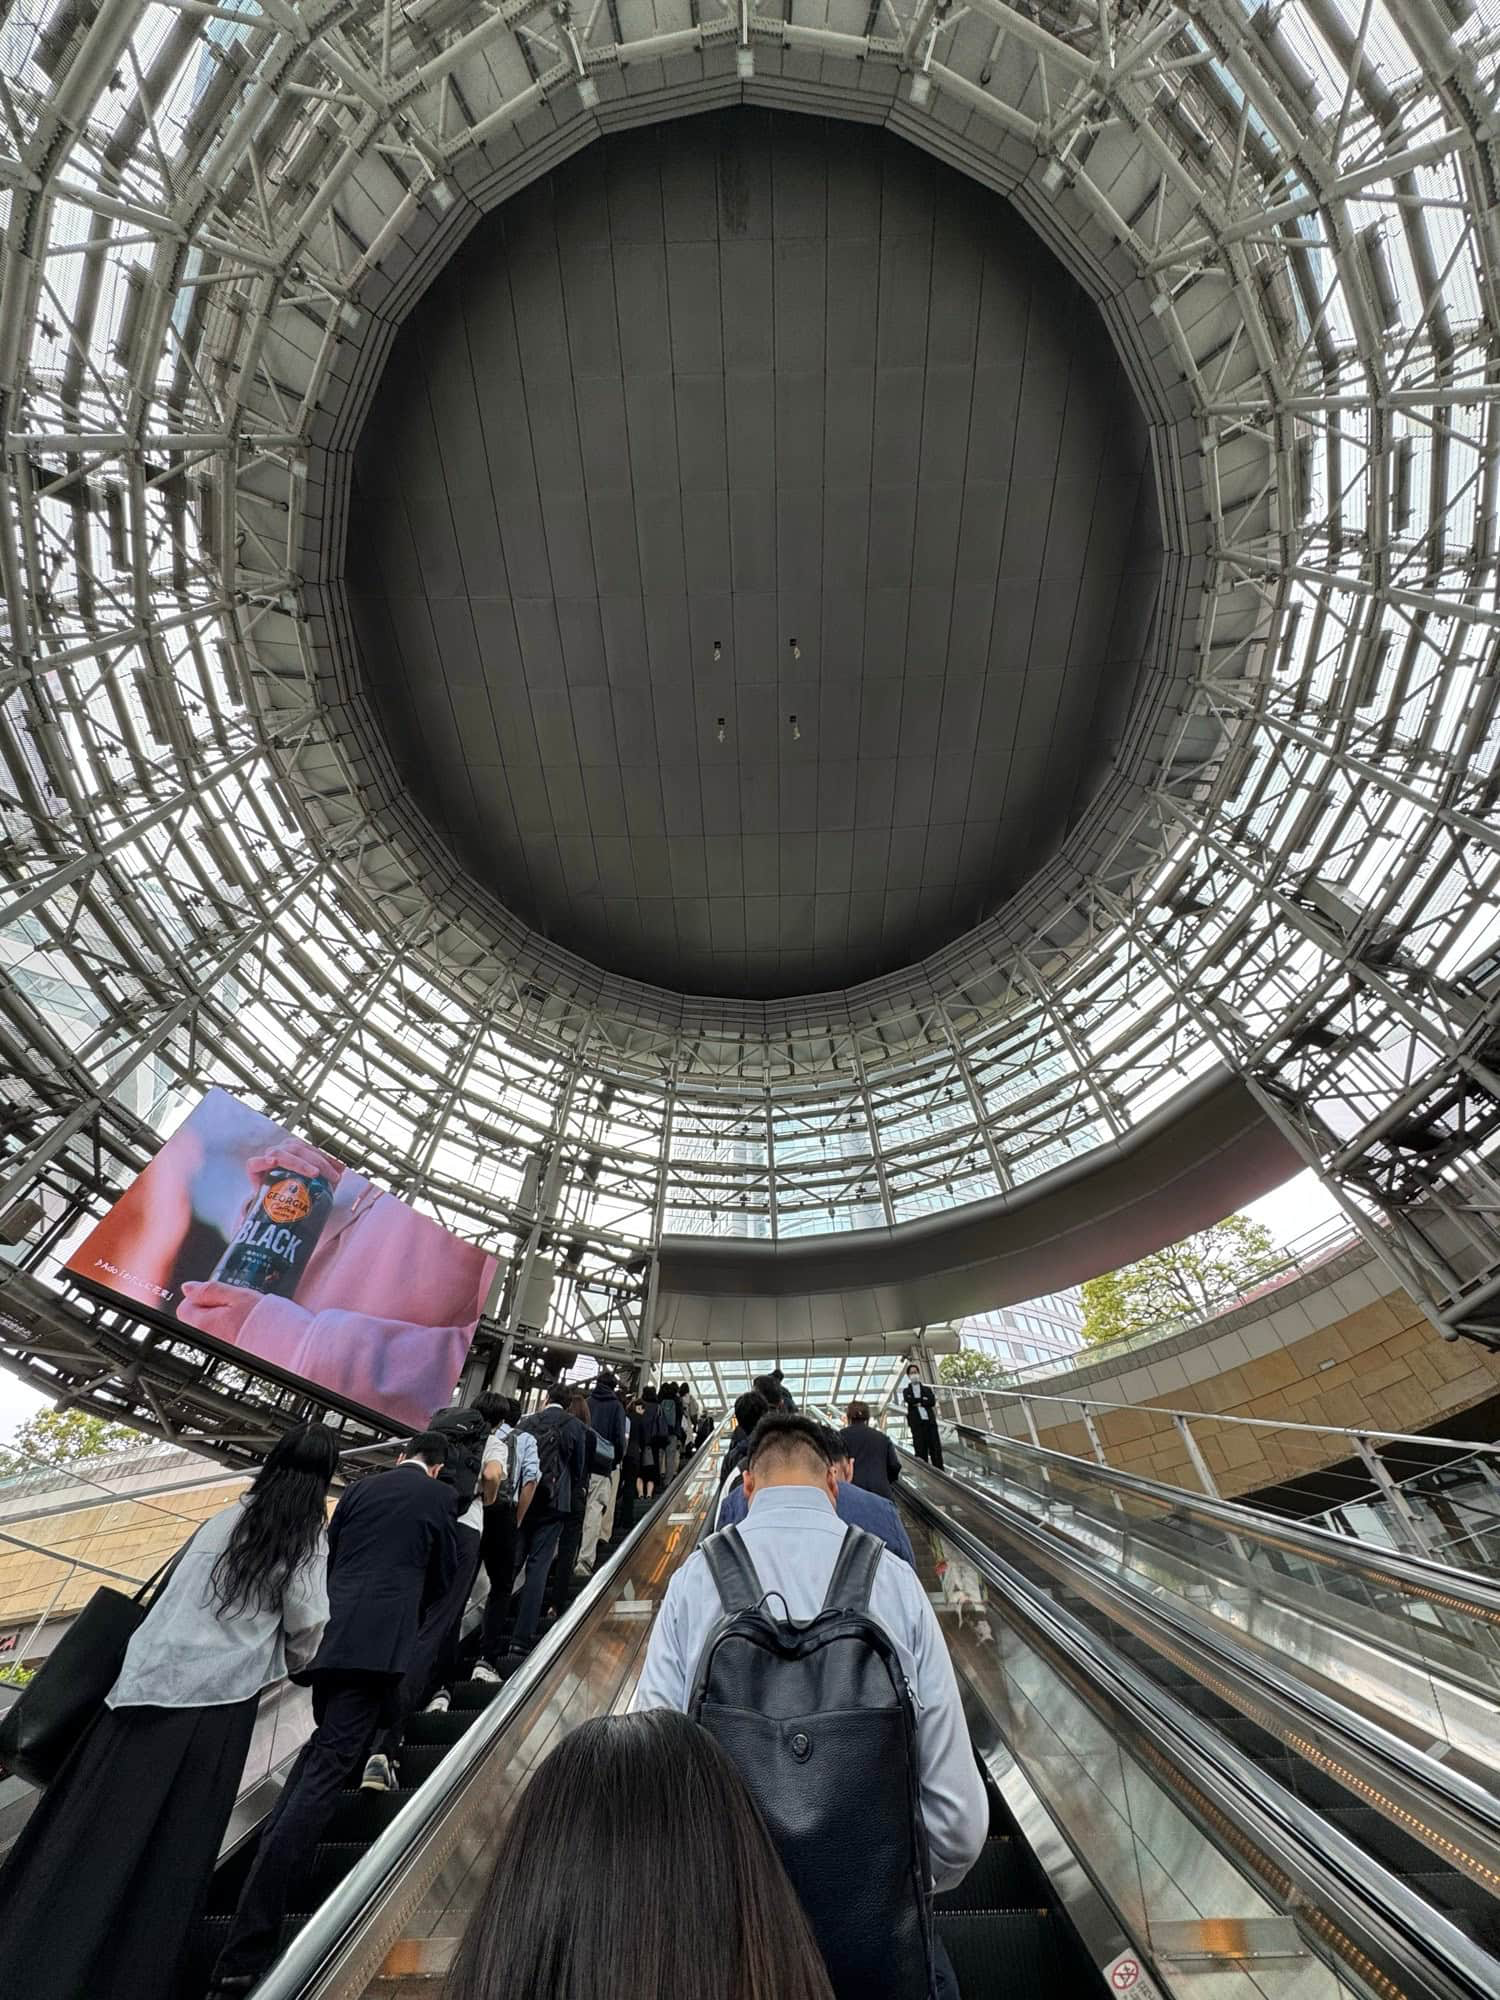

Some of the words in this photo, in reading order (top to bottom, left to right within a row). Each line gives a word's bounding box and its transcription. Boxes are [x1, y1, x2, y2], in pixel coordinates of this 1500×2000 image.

[267, 1191, 309, 1213] GEORGIA
[234, 1219, 302, 1263] BLACK
[101, 1262, 118, 1274] Ado
